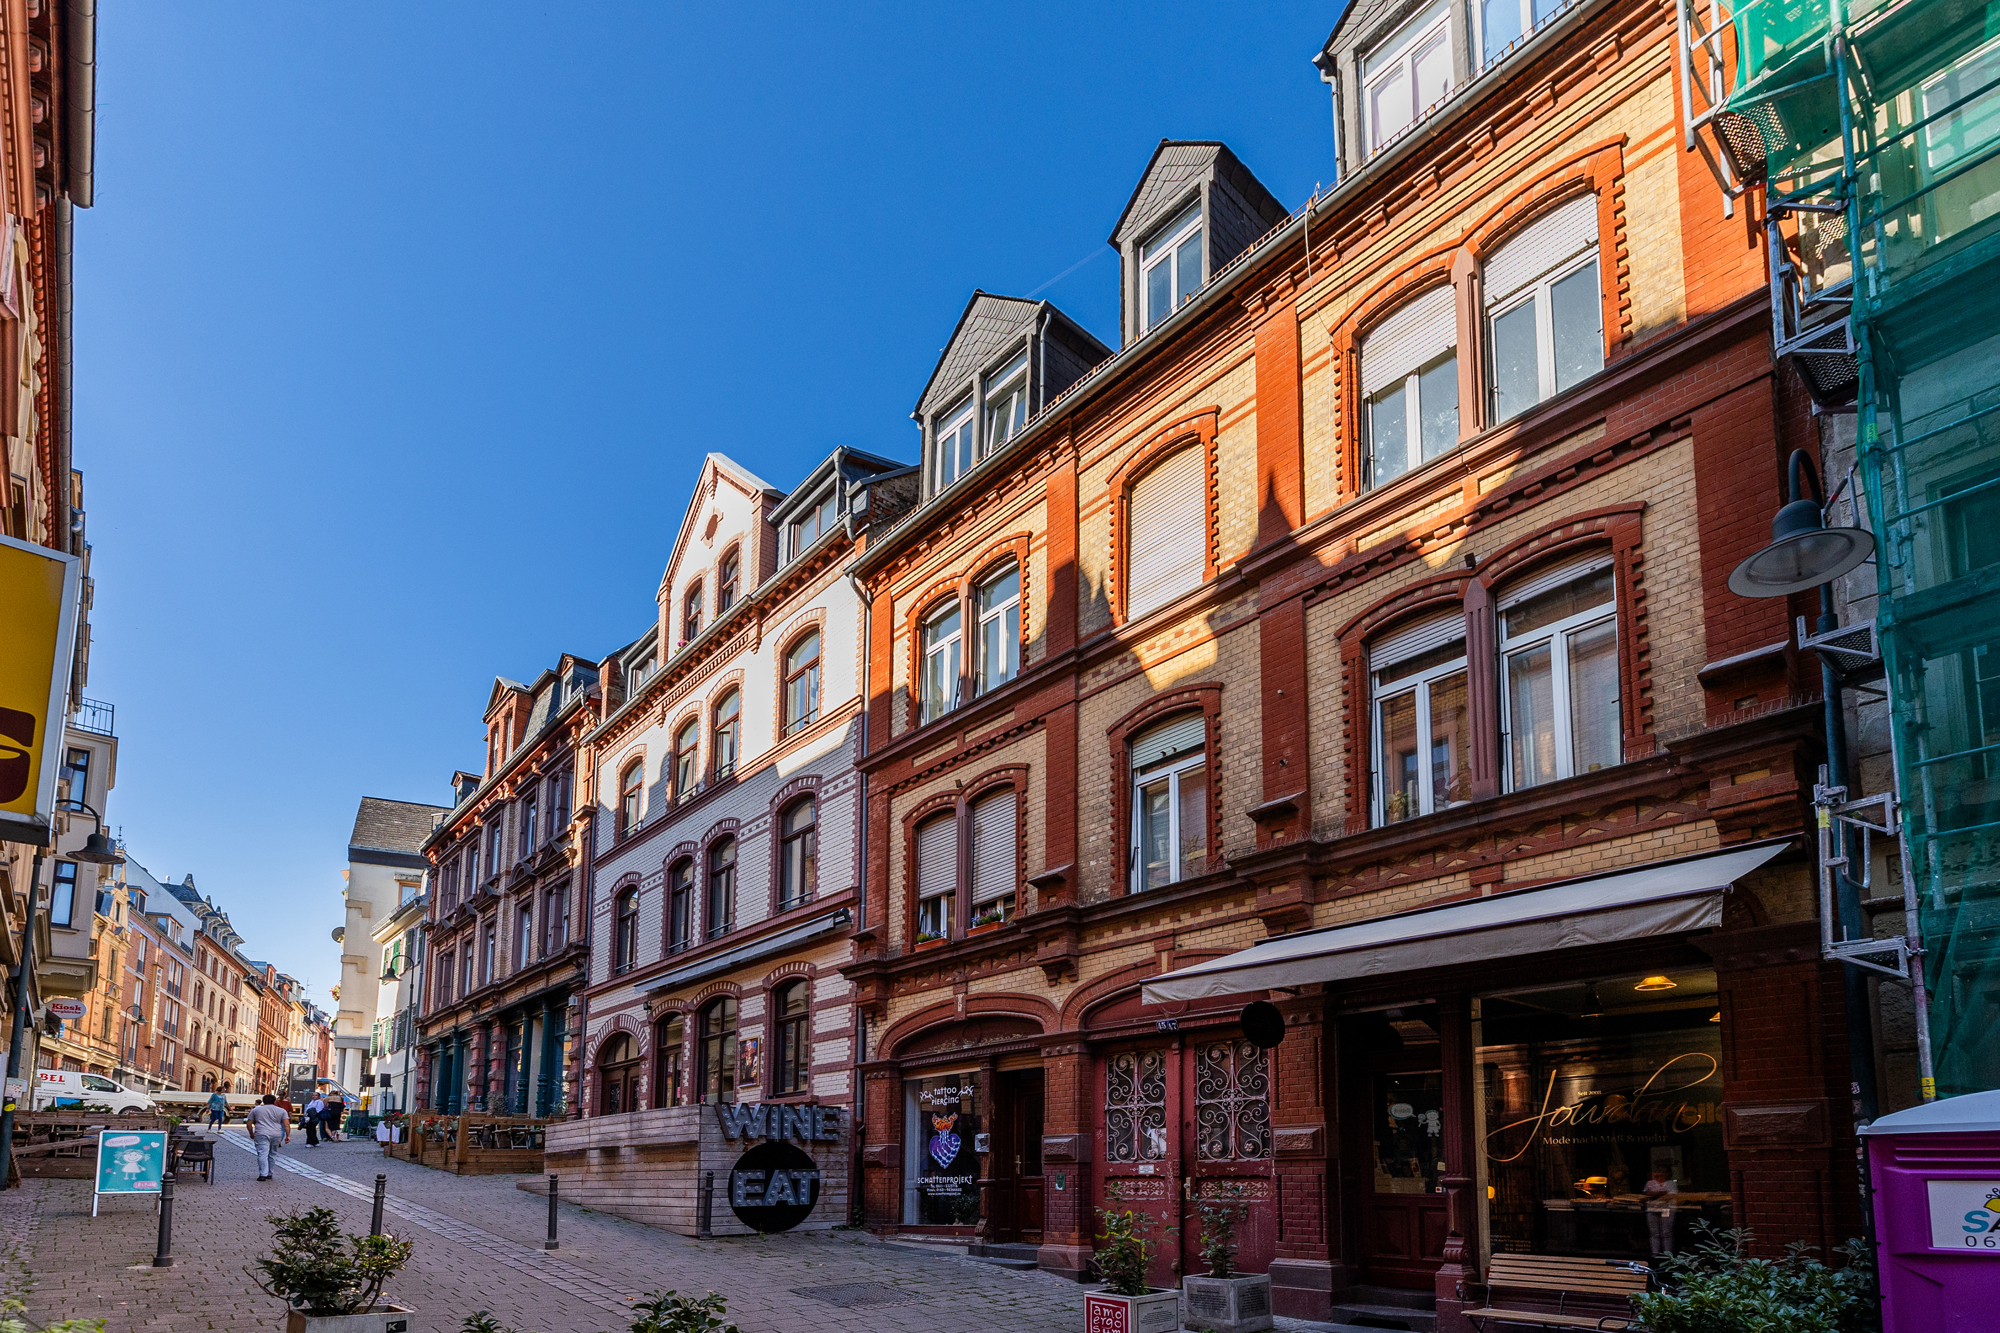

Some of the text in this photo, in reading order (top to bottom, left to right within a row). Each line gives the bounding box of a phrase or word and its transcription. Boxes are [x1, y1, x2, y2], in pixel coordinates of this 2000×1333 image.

[51, 1003, 81, 1011] Kiosk
[1481, 1052, 1716, 1162] Jourdan
[714, 1102, 841, 1141] WINE
[1543, 1133, 1668, 1145] Mode nach Maß & mehr
[733, 1169, 820, 1207] EAT
[1965, 1235, 2000, 1248] 06
[1093, 1315, 1122, 1330] ergo
